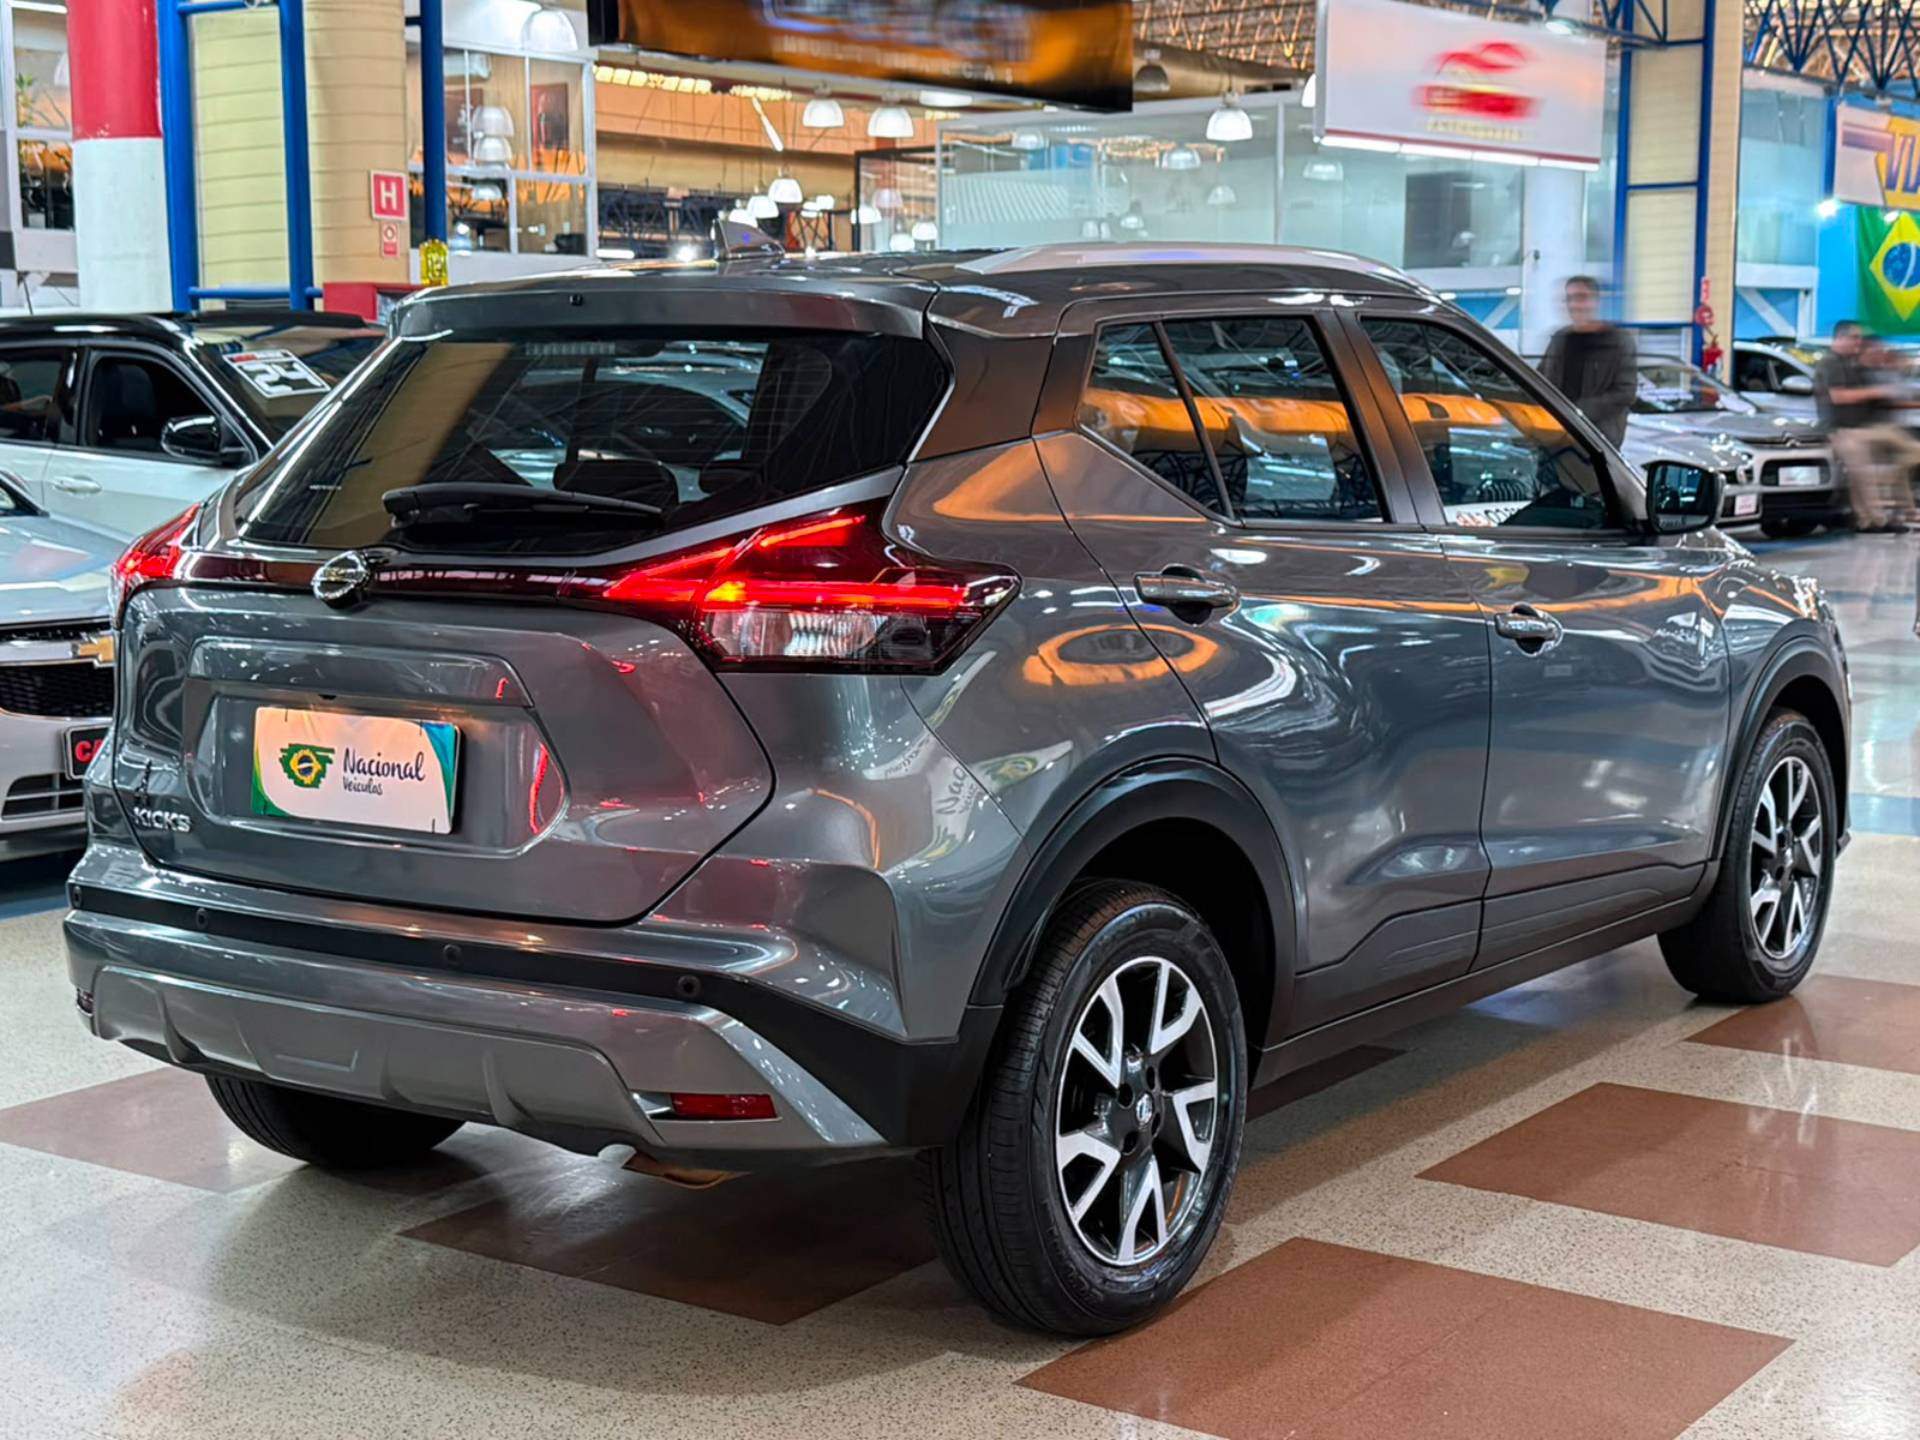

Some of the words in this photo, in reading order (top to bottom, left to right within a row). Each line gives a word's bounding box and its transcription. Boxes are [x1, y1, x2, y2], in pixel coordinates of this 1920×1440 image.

[379, 180, 397, 210] H
[242, 361, 322, 393] 24
[343, 747, 425, 782] Nacional
[133, 806, 191, 833] KICKS
